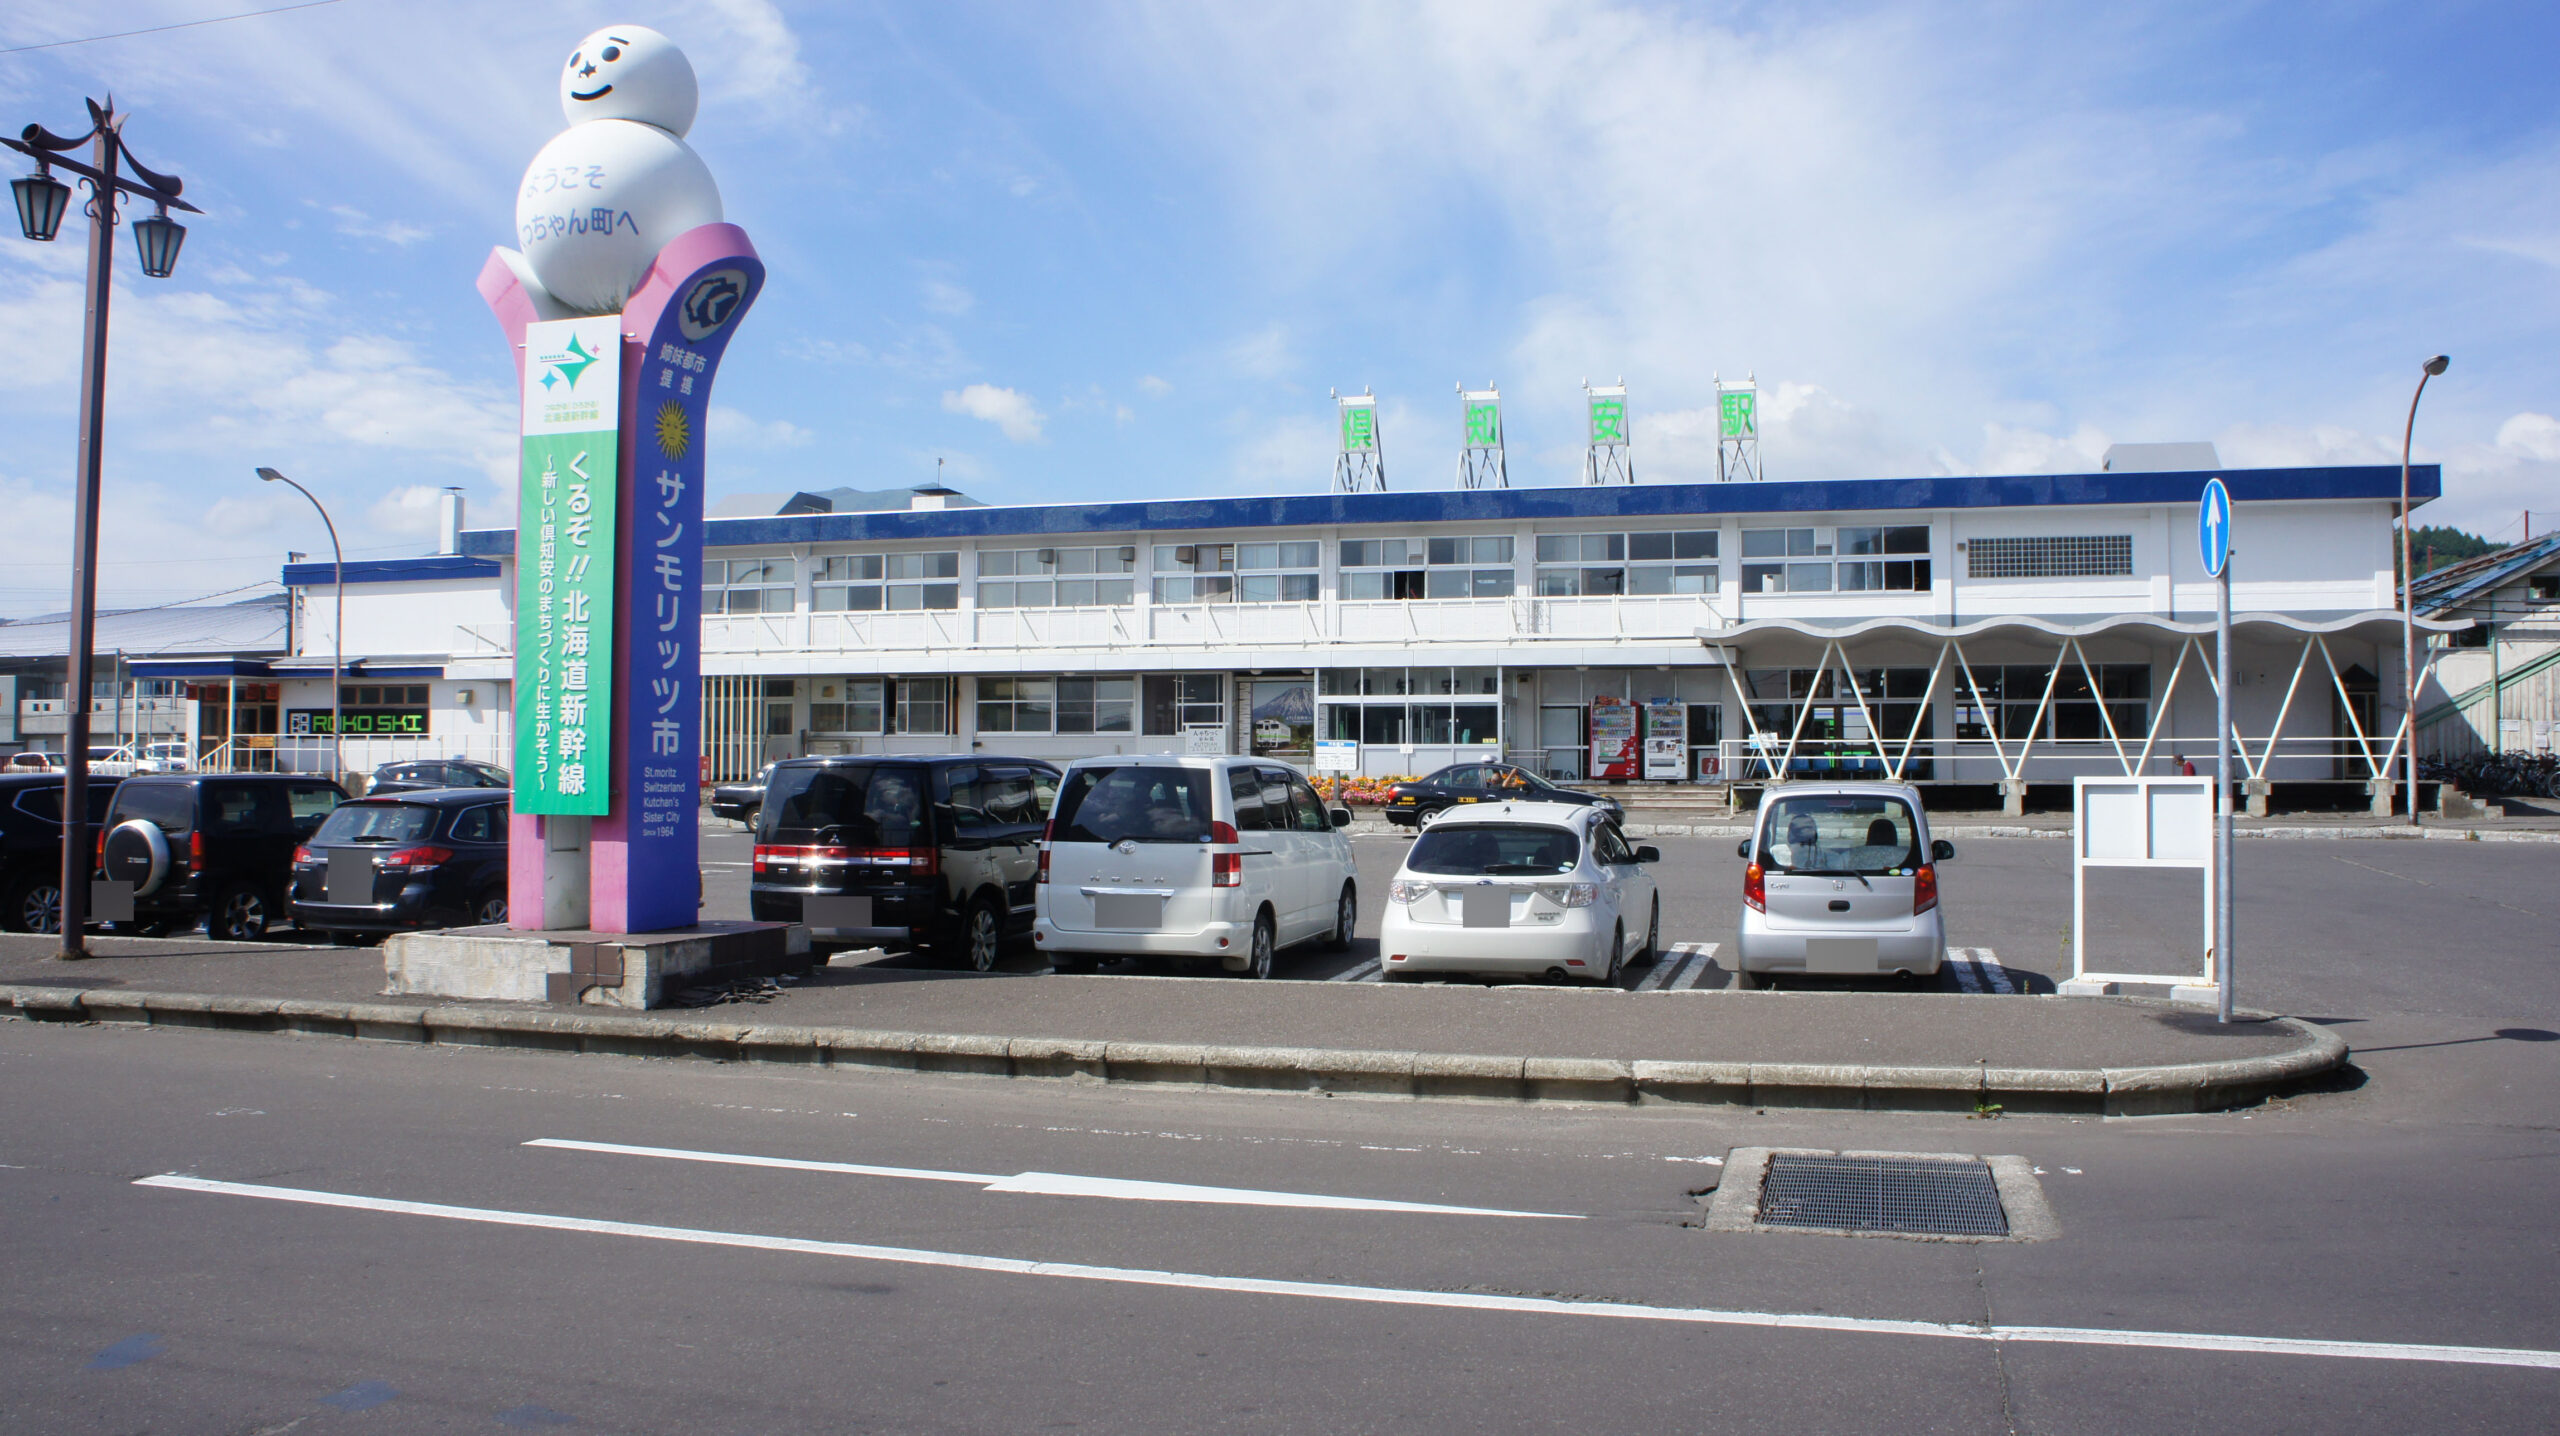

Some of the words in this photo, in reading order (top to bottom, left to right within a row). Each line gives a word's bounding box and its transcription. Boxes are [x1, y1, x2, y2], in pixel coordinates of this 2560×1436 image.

[526, 165, 605, 198] ようこそ
[651, 469, 686, 757] サンモリッツ市
[377, 714, 422, 732] SKI
[643, 782, 686, 793] Switzerland
[643, 797, 679, 808] Kutchan's
[643, 812, 664, 823] Sister
[666, 811, 680, 824] City
[657, 826, 674, 837] 1964
